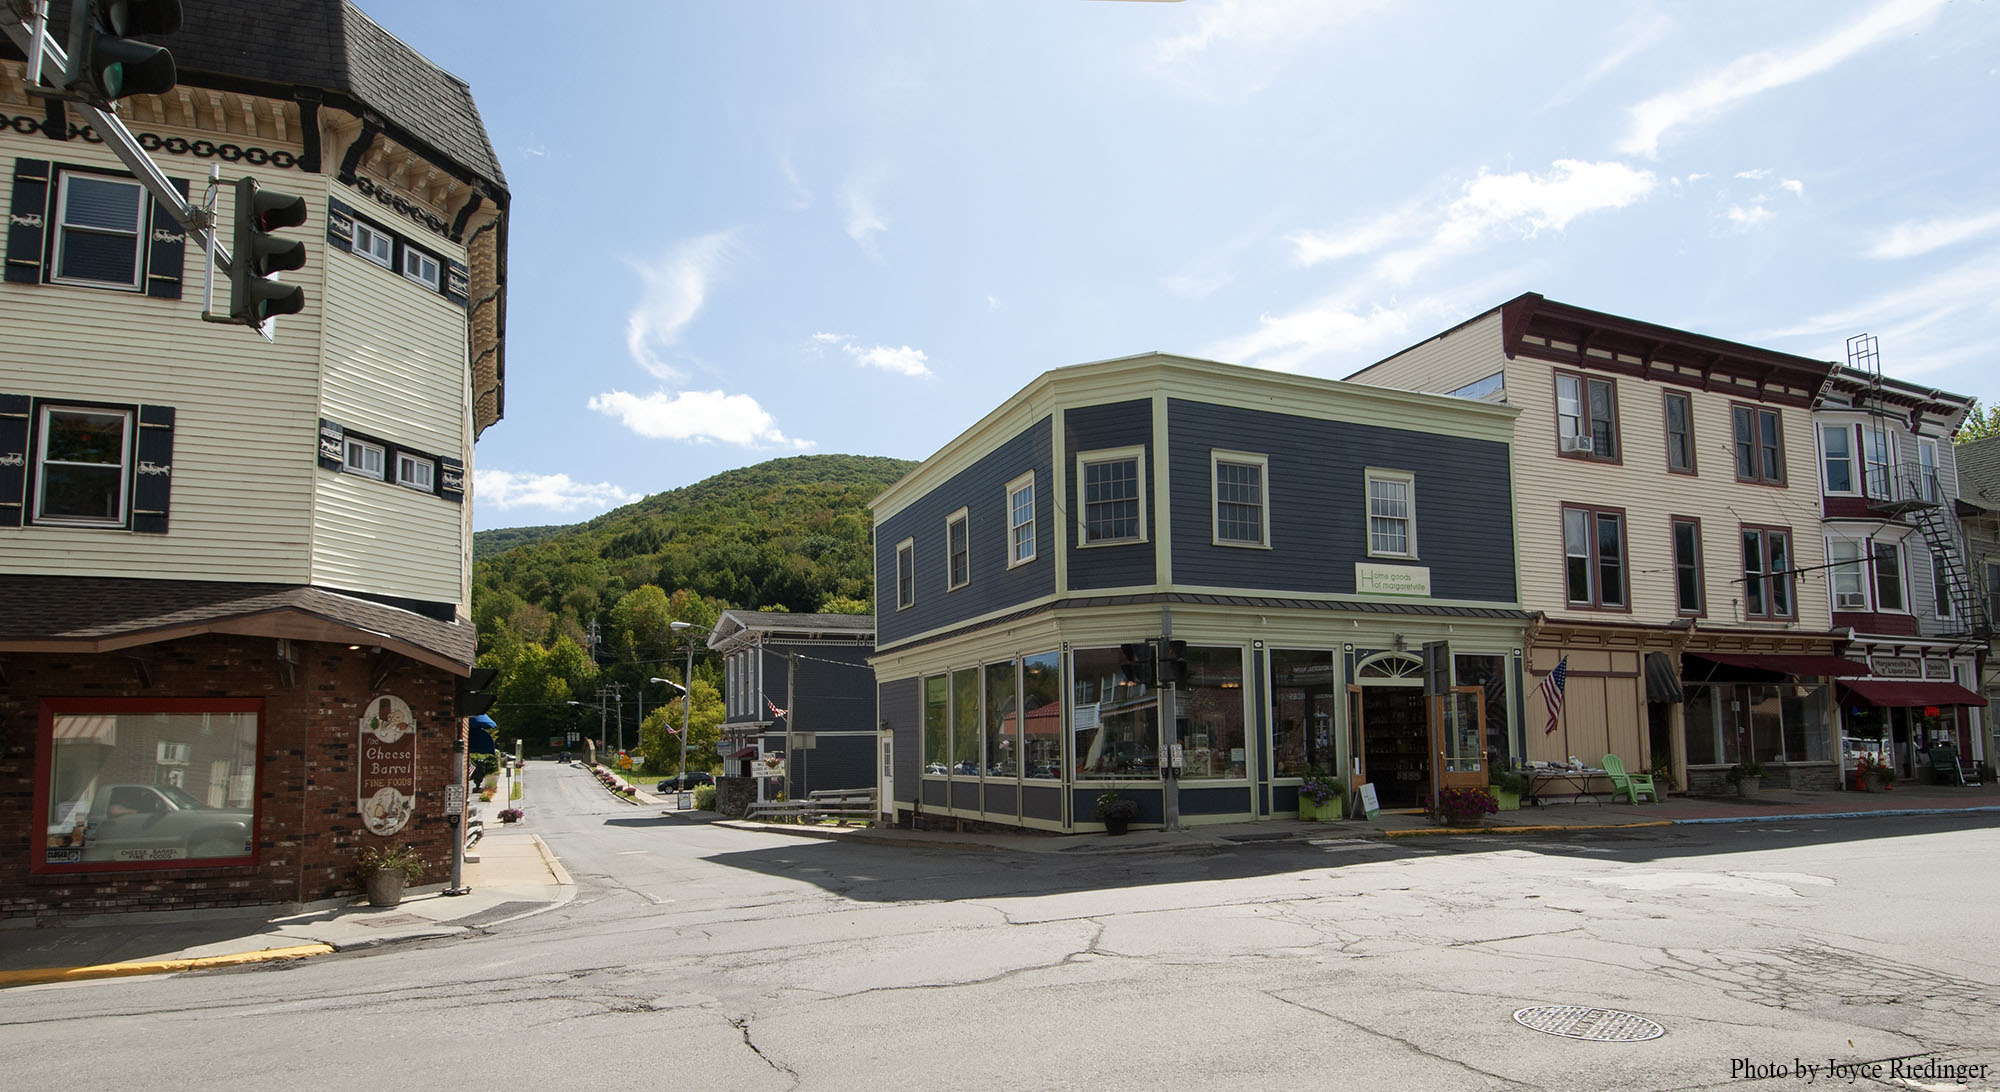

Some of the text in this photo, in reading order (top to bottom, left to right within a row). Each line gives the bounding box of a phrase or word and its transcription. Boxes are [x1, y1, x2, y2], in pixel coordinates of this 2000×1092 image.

[1361, 569, 1412, 588] Home goods
[1383, 583, 1426, 591] margaretville
[366, 745, 411, 760] Cheese
[370, 761, 411, 775] Barrel
[364, 777, 412, 788] FINE FOODS
